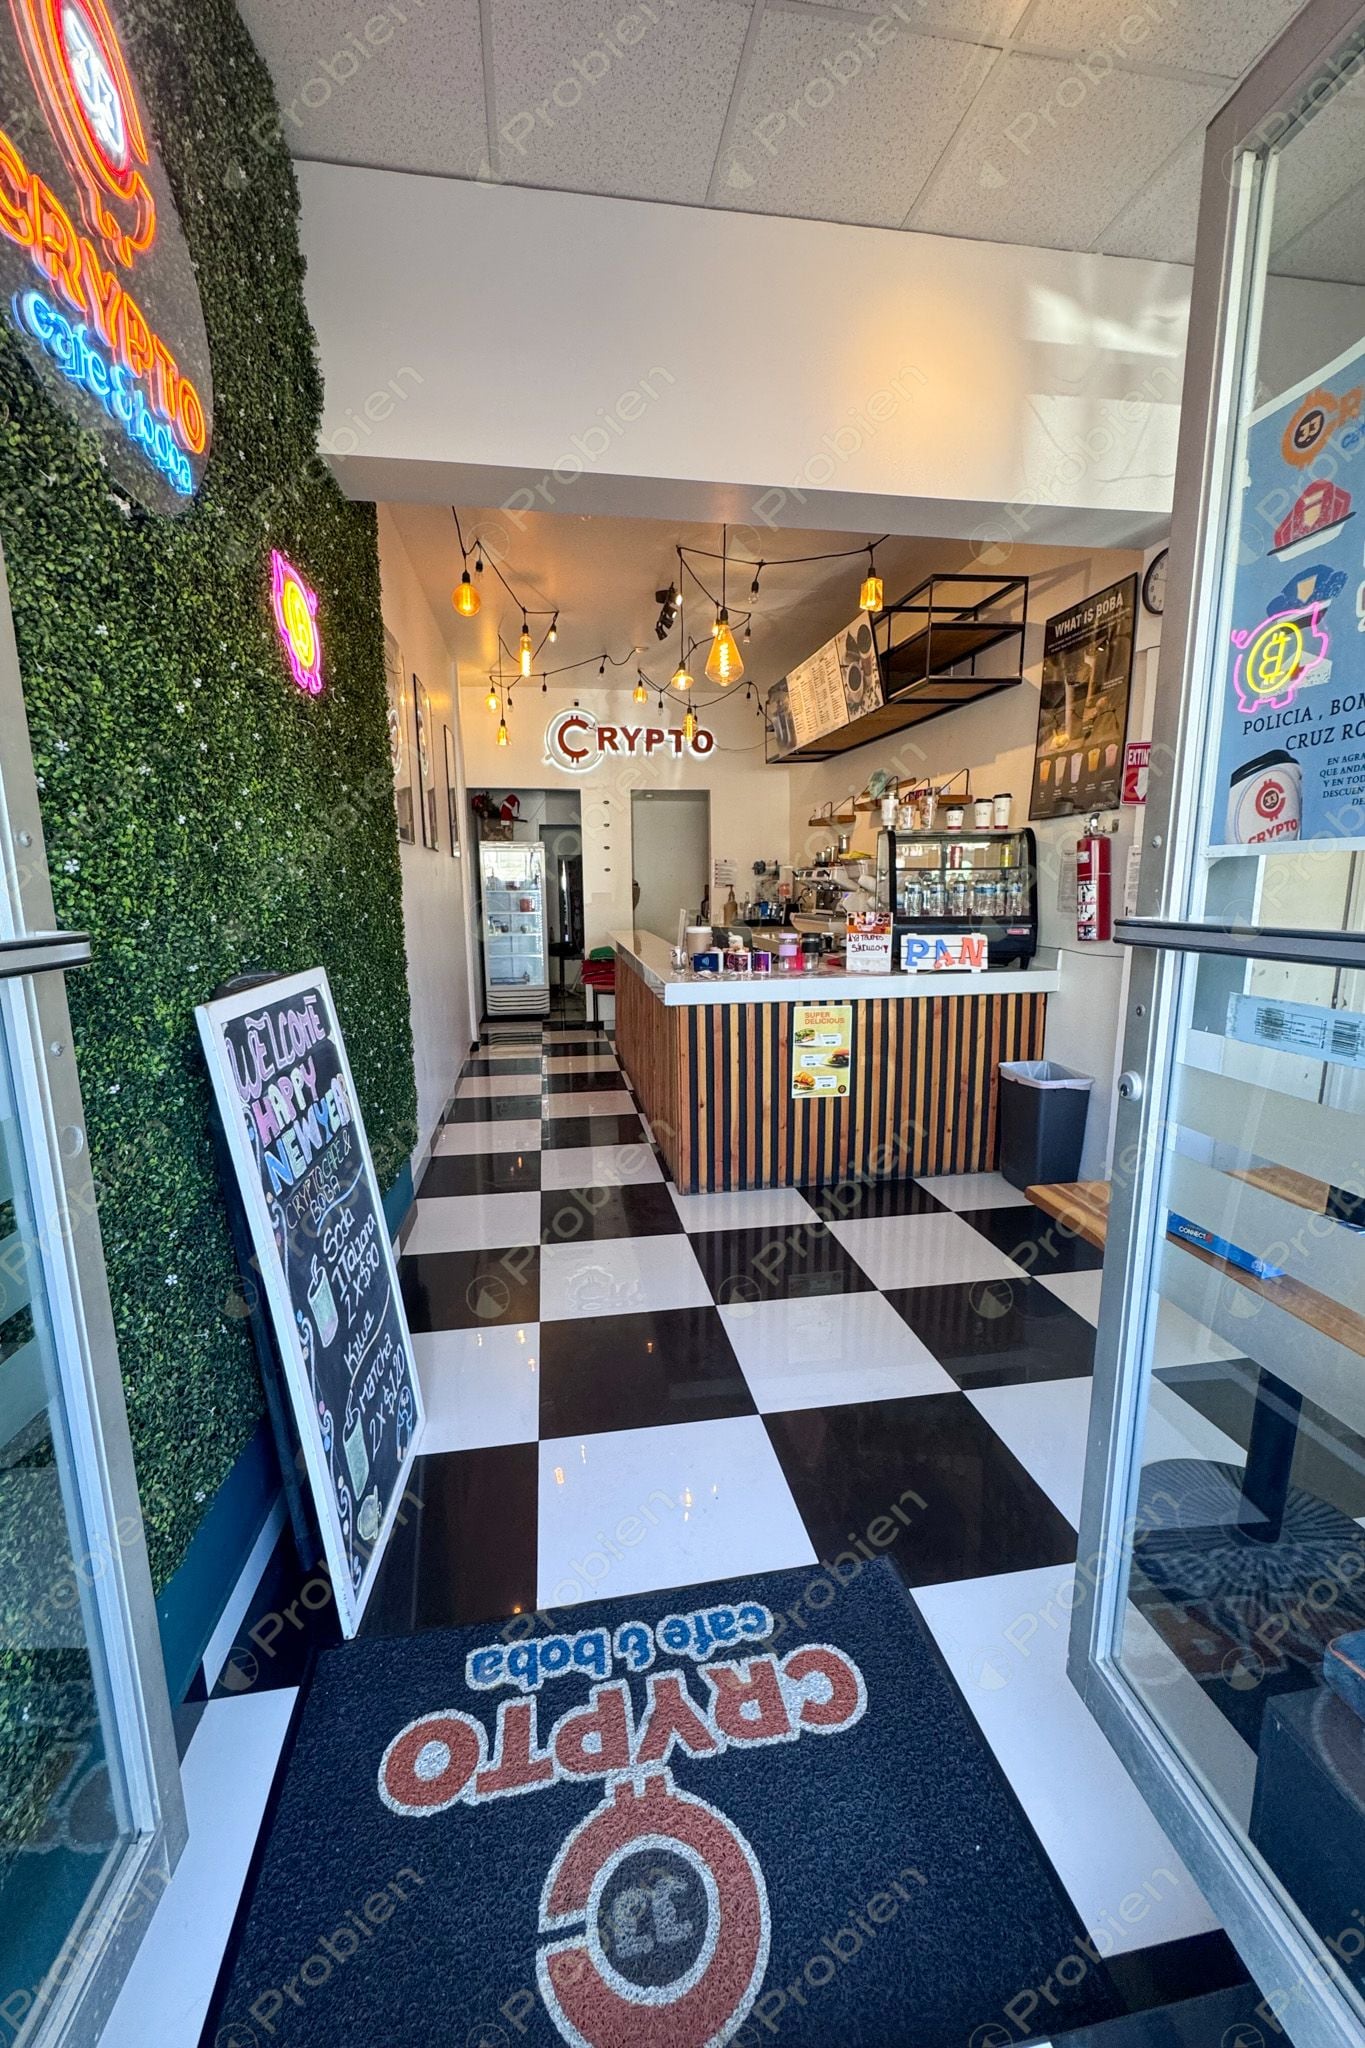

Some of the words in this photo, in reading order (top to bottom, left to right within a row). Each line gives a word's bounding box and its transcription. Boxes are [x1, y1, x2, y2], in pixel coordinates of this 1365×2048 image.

[1055, 613, 1083, 638] WHAT
[1083, 608, 1094, 624] IS
[1095, 592, 1124, 617] BOBA
[1242, 706, 1313, 736] POLICIA
[557, 716, 714, 764] CRYPTO
[1285, 727, 1335, 750] CRUZ
[1319, 767, 1338, 778] QUE
[1327, 756, 1341, 766] EN
[1322, 786, 1365, 799] DESCUEN
[1323, 779, 1330, 788] Y
[1332, 777, 1344, 787] EN
[905, 937, 986, 970] PAN
[804, 1011, 831, 1019] SUPER
[804, 1017, 845, 1025] DELICIOUS
[224, 995, 326, 1102] WELCOME
[251, 1056, 319, 1148] HAPPY
[310, 1175, 341, 1224] BOBA
[658, 1602, 772, 1660] cafe
[466, 1627, 612, 1692] boba
[378, 1643, 868, 1817] CRYPTO
